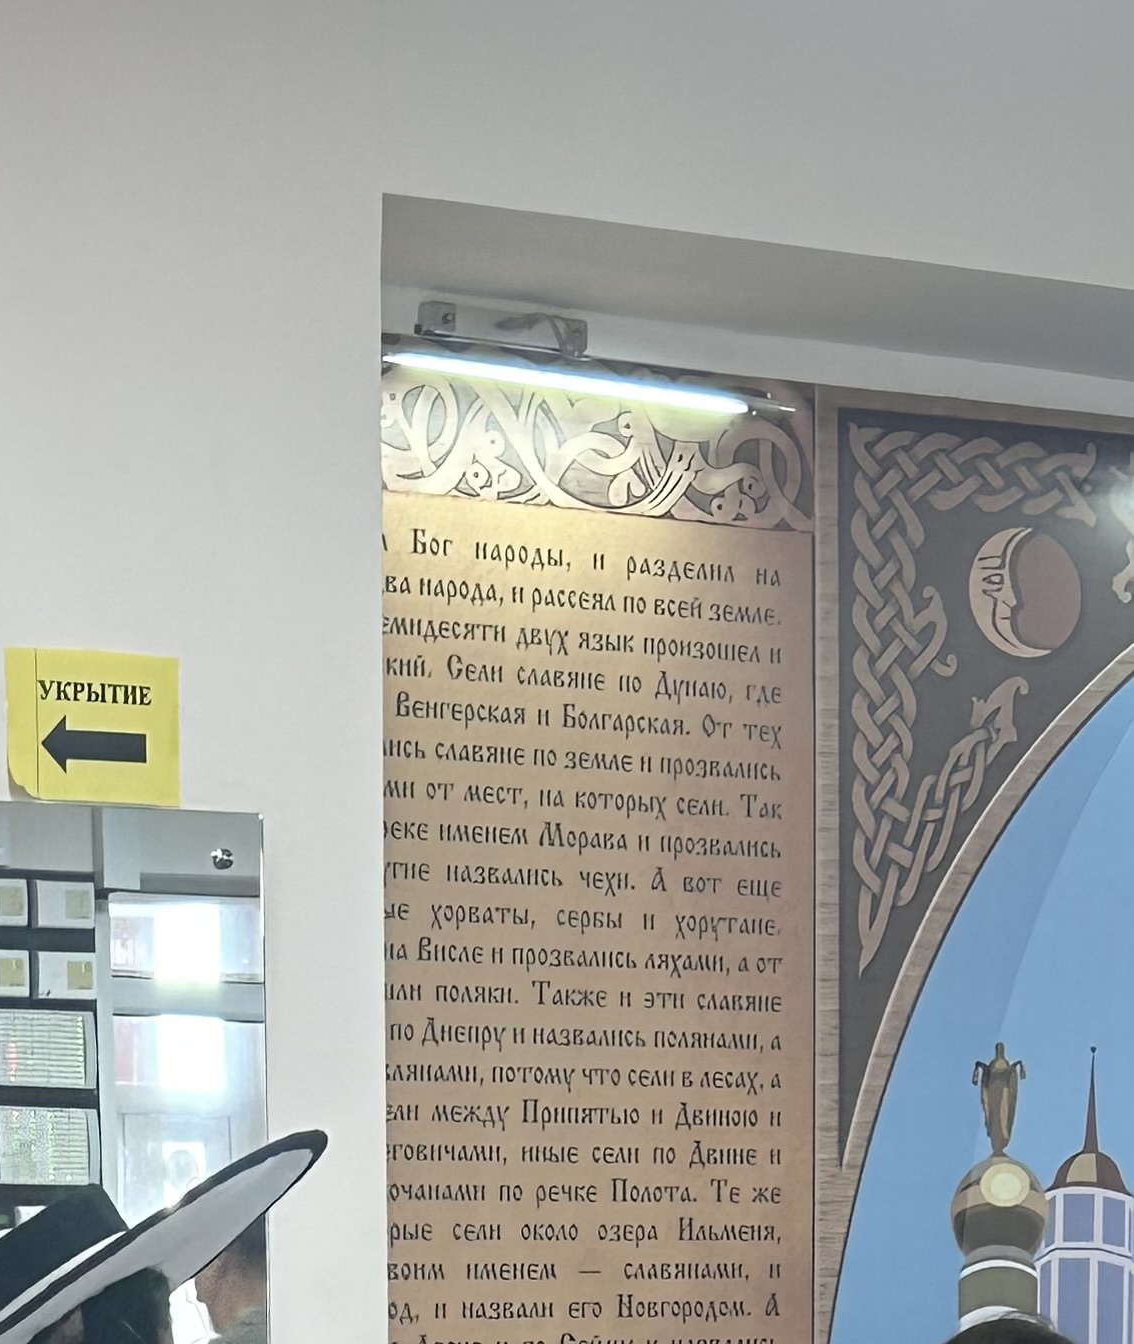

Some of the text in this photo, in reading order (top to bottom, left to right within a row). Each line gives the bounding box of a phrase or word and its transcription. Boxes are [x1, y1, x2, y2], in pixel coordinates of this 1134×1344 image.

[410, 527, 453, 557] Бог
[475, 541, 571, 573] народы,
[593, 552, 605, 571] и
[626, 555, 735, 584] разделил
[755, 567, 781, 587] на
[419, 577, 504, 607] народа,
[511, 585, 524, 605] и
[531, 587, 617, 614] рассеял
[623, 595, 647, 615] по
[653, 596, 703, 620] всей
[515, 627, 781, 665] двух язык произошел и
[37, 679, 152, 706] УКРЫТИЕ
[446, 653, 782, 706] Сели славяне по Дунаю, где
[395, 690, 782, 750] Венгерская и Болгарская. От тех
[434, 741, 781, 782] славяне по земле и прозвались
[425, 782, 782, 822] от мест, на которых сели. Так
[439, 821, 782, 861] именем Морава и прозвались
[446, 864, 782, 903] назвались чехи. А вот еще
[430, 903, 536, 931] хорваты,
[556, 908, 623, 936] сербы
[643, 912, 655, 931] и
[416, 936, 784, 979] Висле и прозвались ляхами, а от
[435, 980, 782, 1013] поляки. Также и эти славяне
[421, 1016, 507, 1053] Днепру
[512, 1027, 526, 1045] и
[532, 1027, 647, 1048] назвались
[653, 1030, 764, 1054] полянами,
[770, 1034, 782, 1051] а
[491, 1065, 782, 1096] потому что сели в лесах, а
[431, 1098, 782, 1132] между Припятью и Двиною и
[521, 1139, 781, 1170] иные сели по Двине и
[499, 1184, 523, 1203] по
[535, 1184, 598, 1209] речке
[610, 1177, 698, 1204] Полота.
[709, 1178, 741, 1204] Те
[751, 1186, 782, 1205] же
[452, 1216, 782, 1249] сели около озера Ильменя,
[466, 1262, 557, 1281] именем
[623, 1262, 750, 1282] славянами,
[769, 1263, 781, 1280] и
[434, 1292, 781, 1325] и назвали его Новгородом. А
